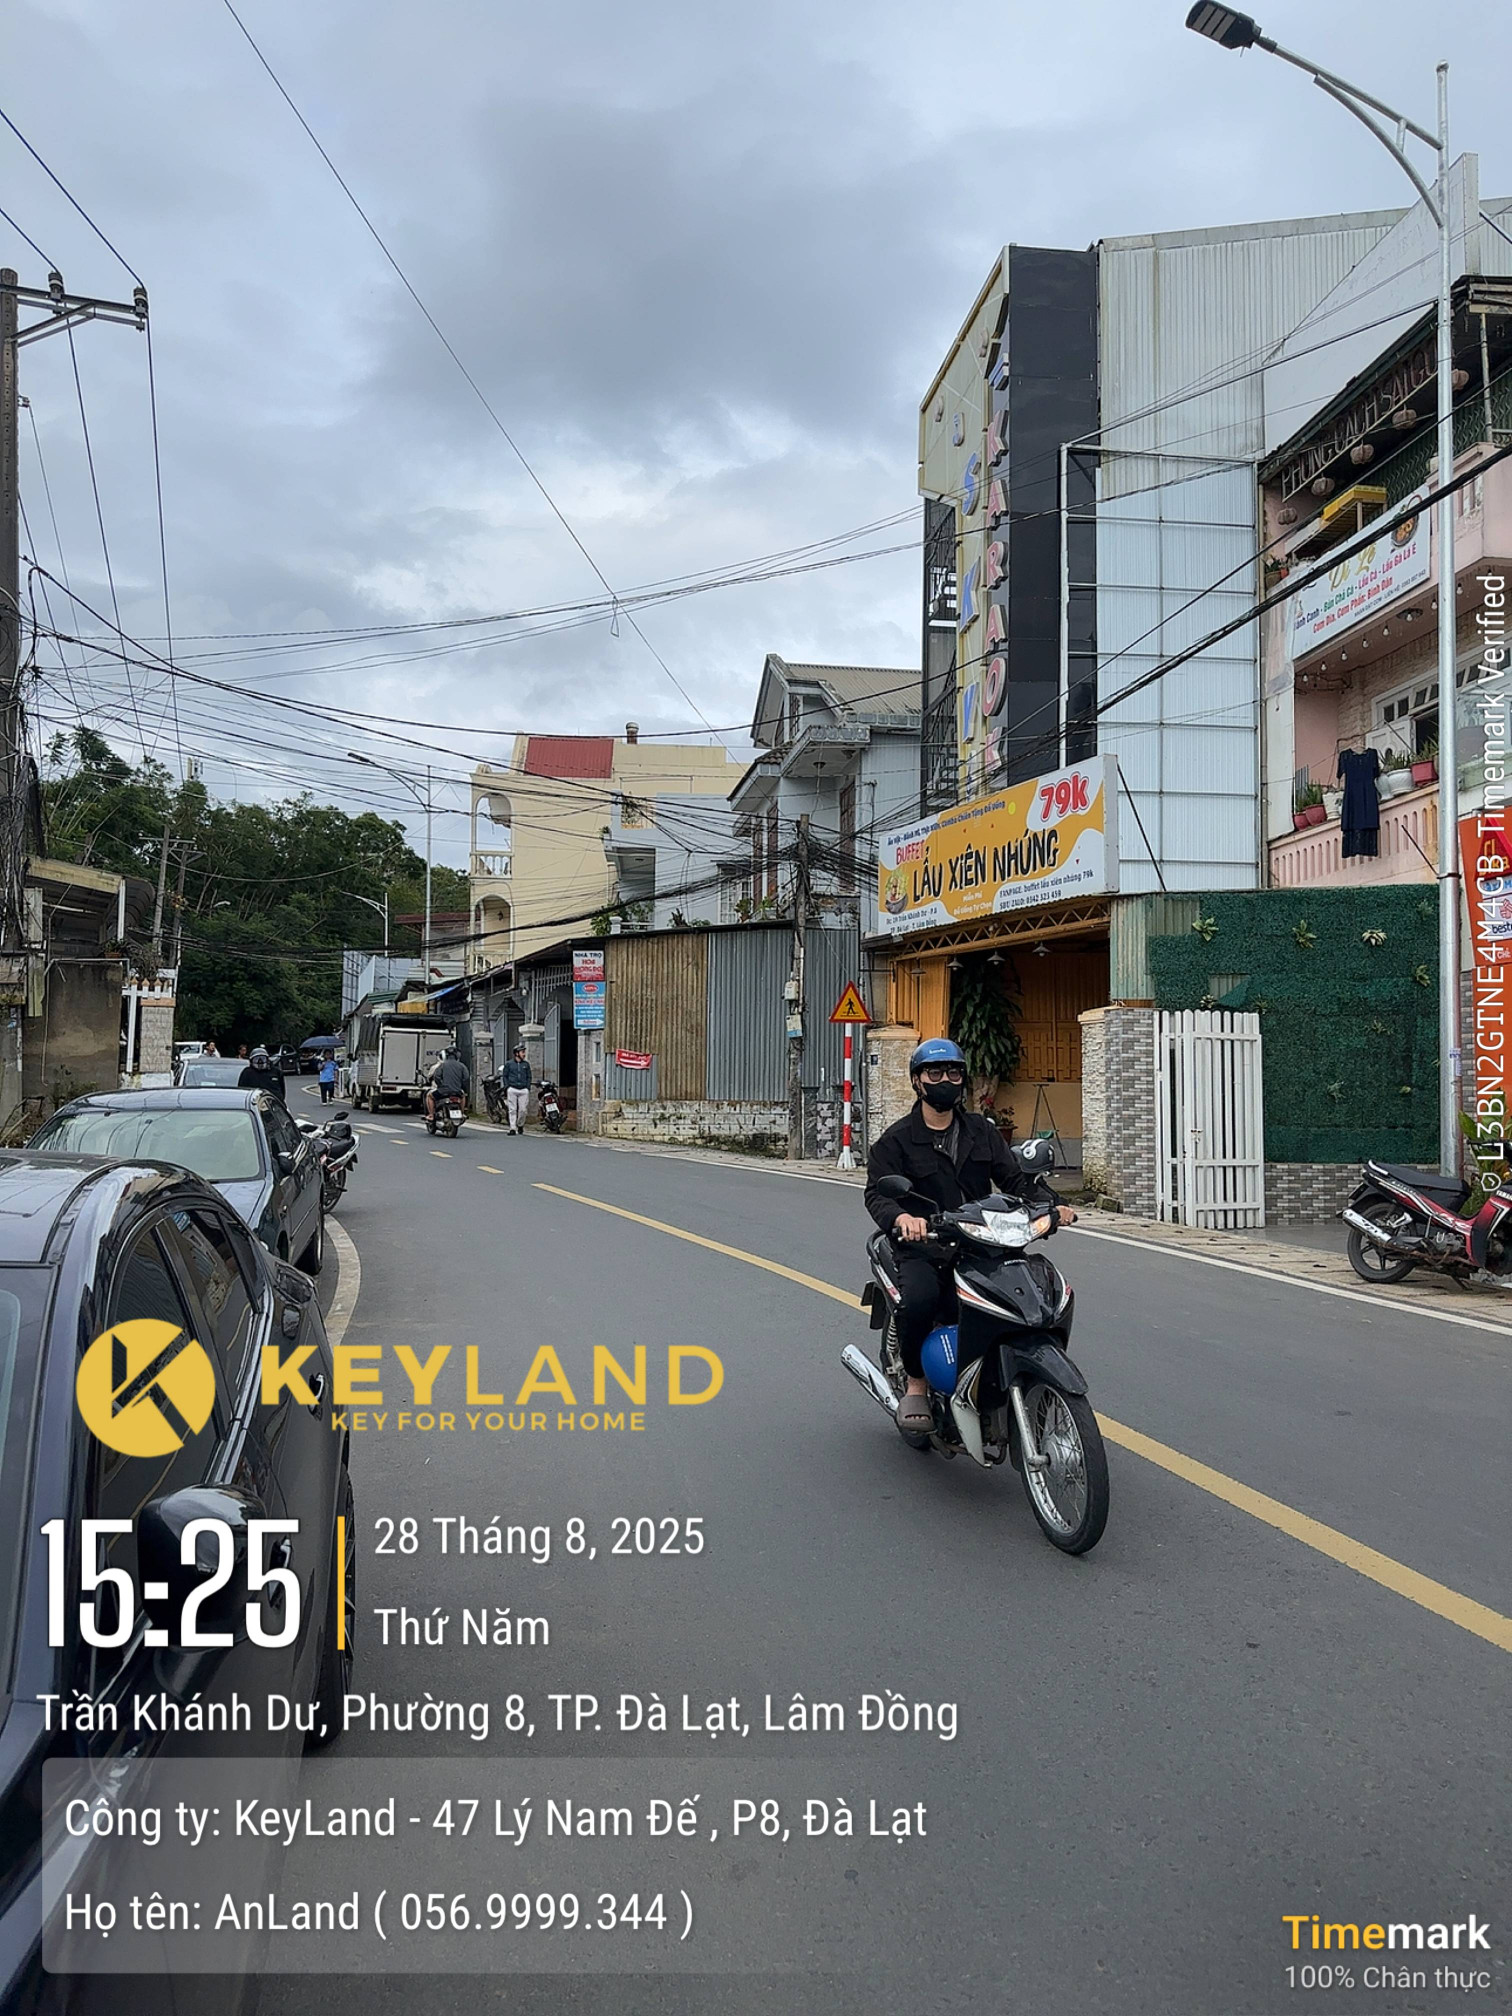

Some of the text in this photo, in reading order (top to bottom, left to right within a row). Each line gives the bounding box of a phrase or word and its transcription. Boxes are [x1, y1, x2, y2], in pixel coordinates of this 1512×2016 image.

[1040, 774, 1089, 821] 79k
[896, 840, 926, 866] BUFFET
[914, 828, 1060, 902] LẨU XIÊN NHÚNG
